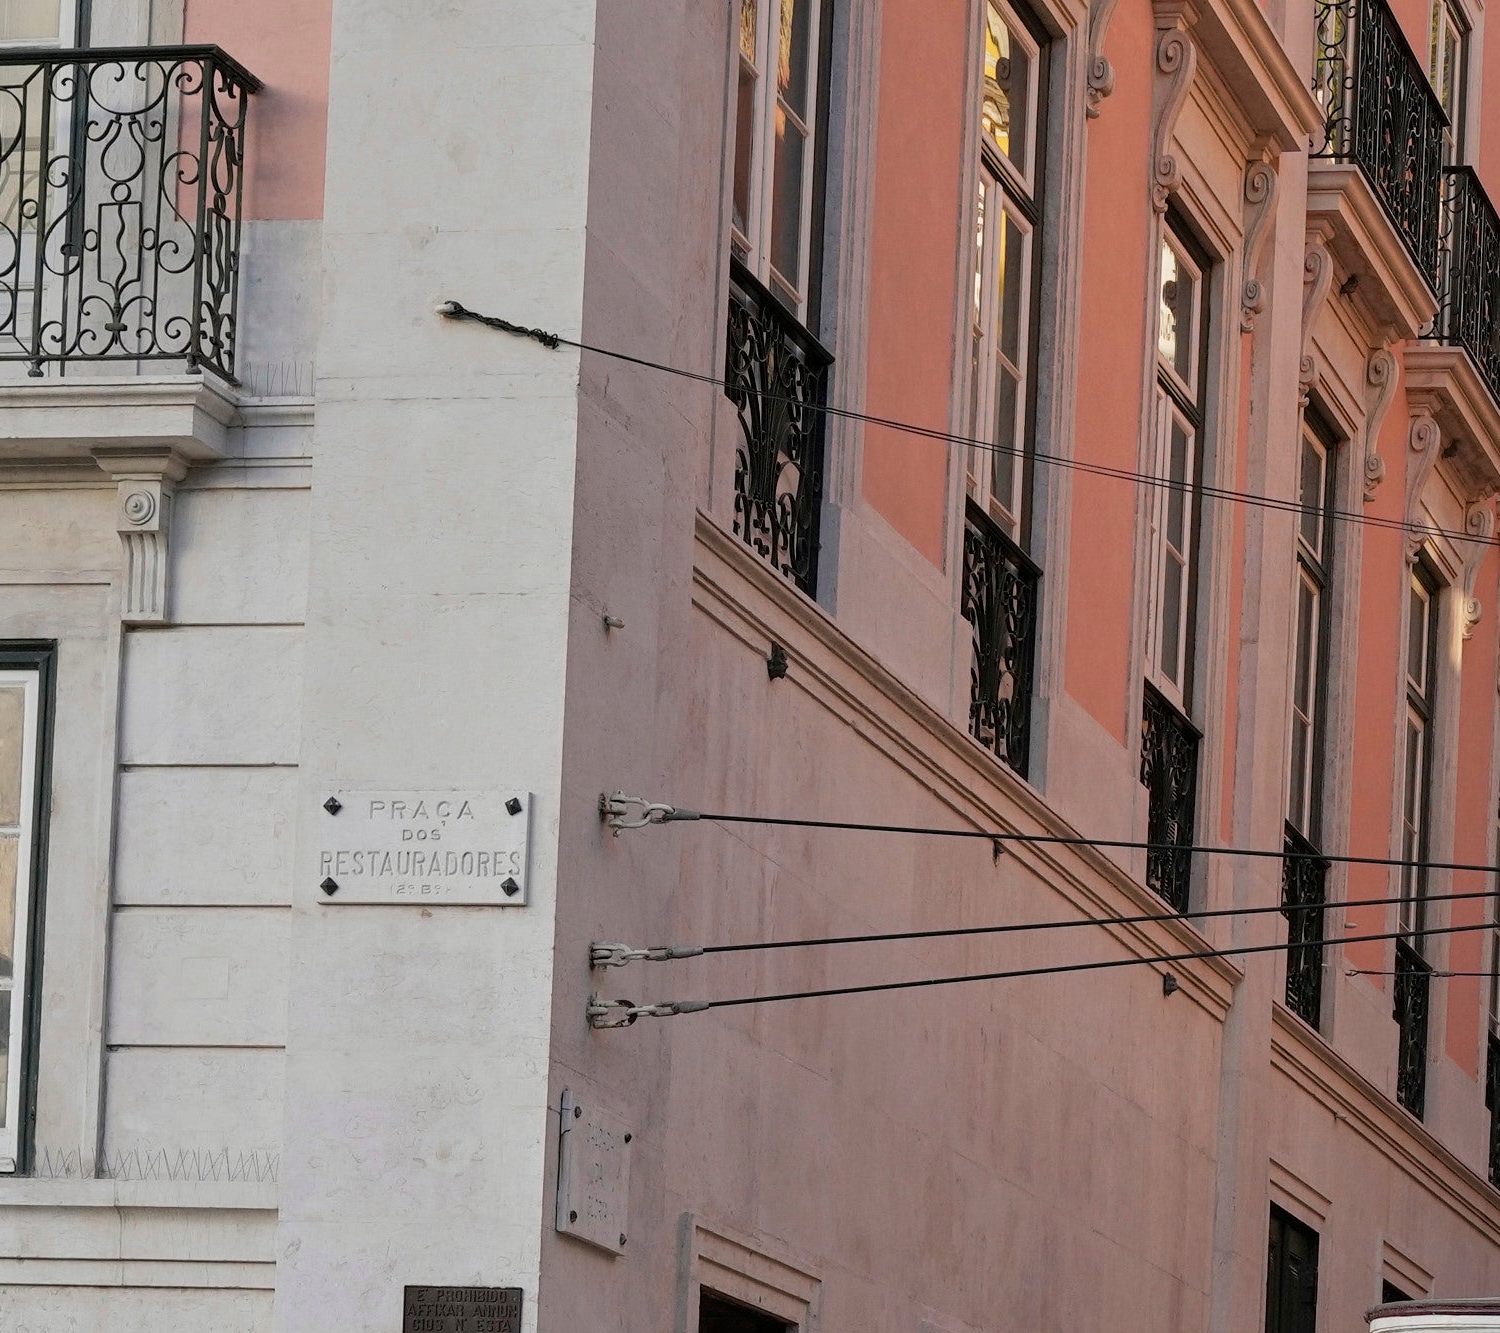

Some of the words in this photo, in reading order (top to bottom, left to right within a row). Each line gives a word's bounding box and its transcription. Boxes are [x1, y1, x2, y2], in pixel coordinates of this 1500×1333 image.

[369, 800, 474, 826] PRAÇA
[402, 829, 441, 841] DOS
[320, 851, 521, 877] RESTAURADORES
[407, 1304, 464, 1317] AFFIXAR
[473, 1305, 518, 1318] ANNUN
[412, 1319, 443, 1332] CIOS
[476, 1320, 511, 1332] ESTA
